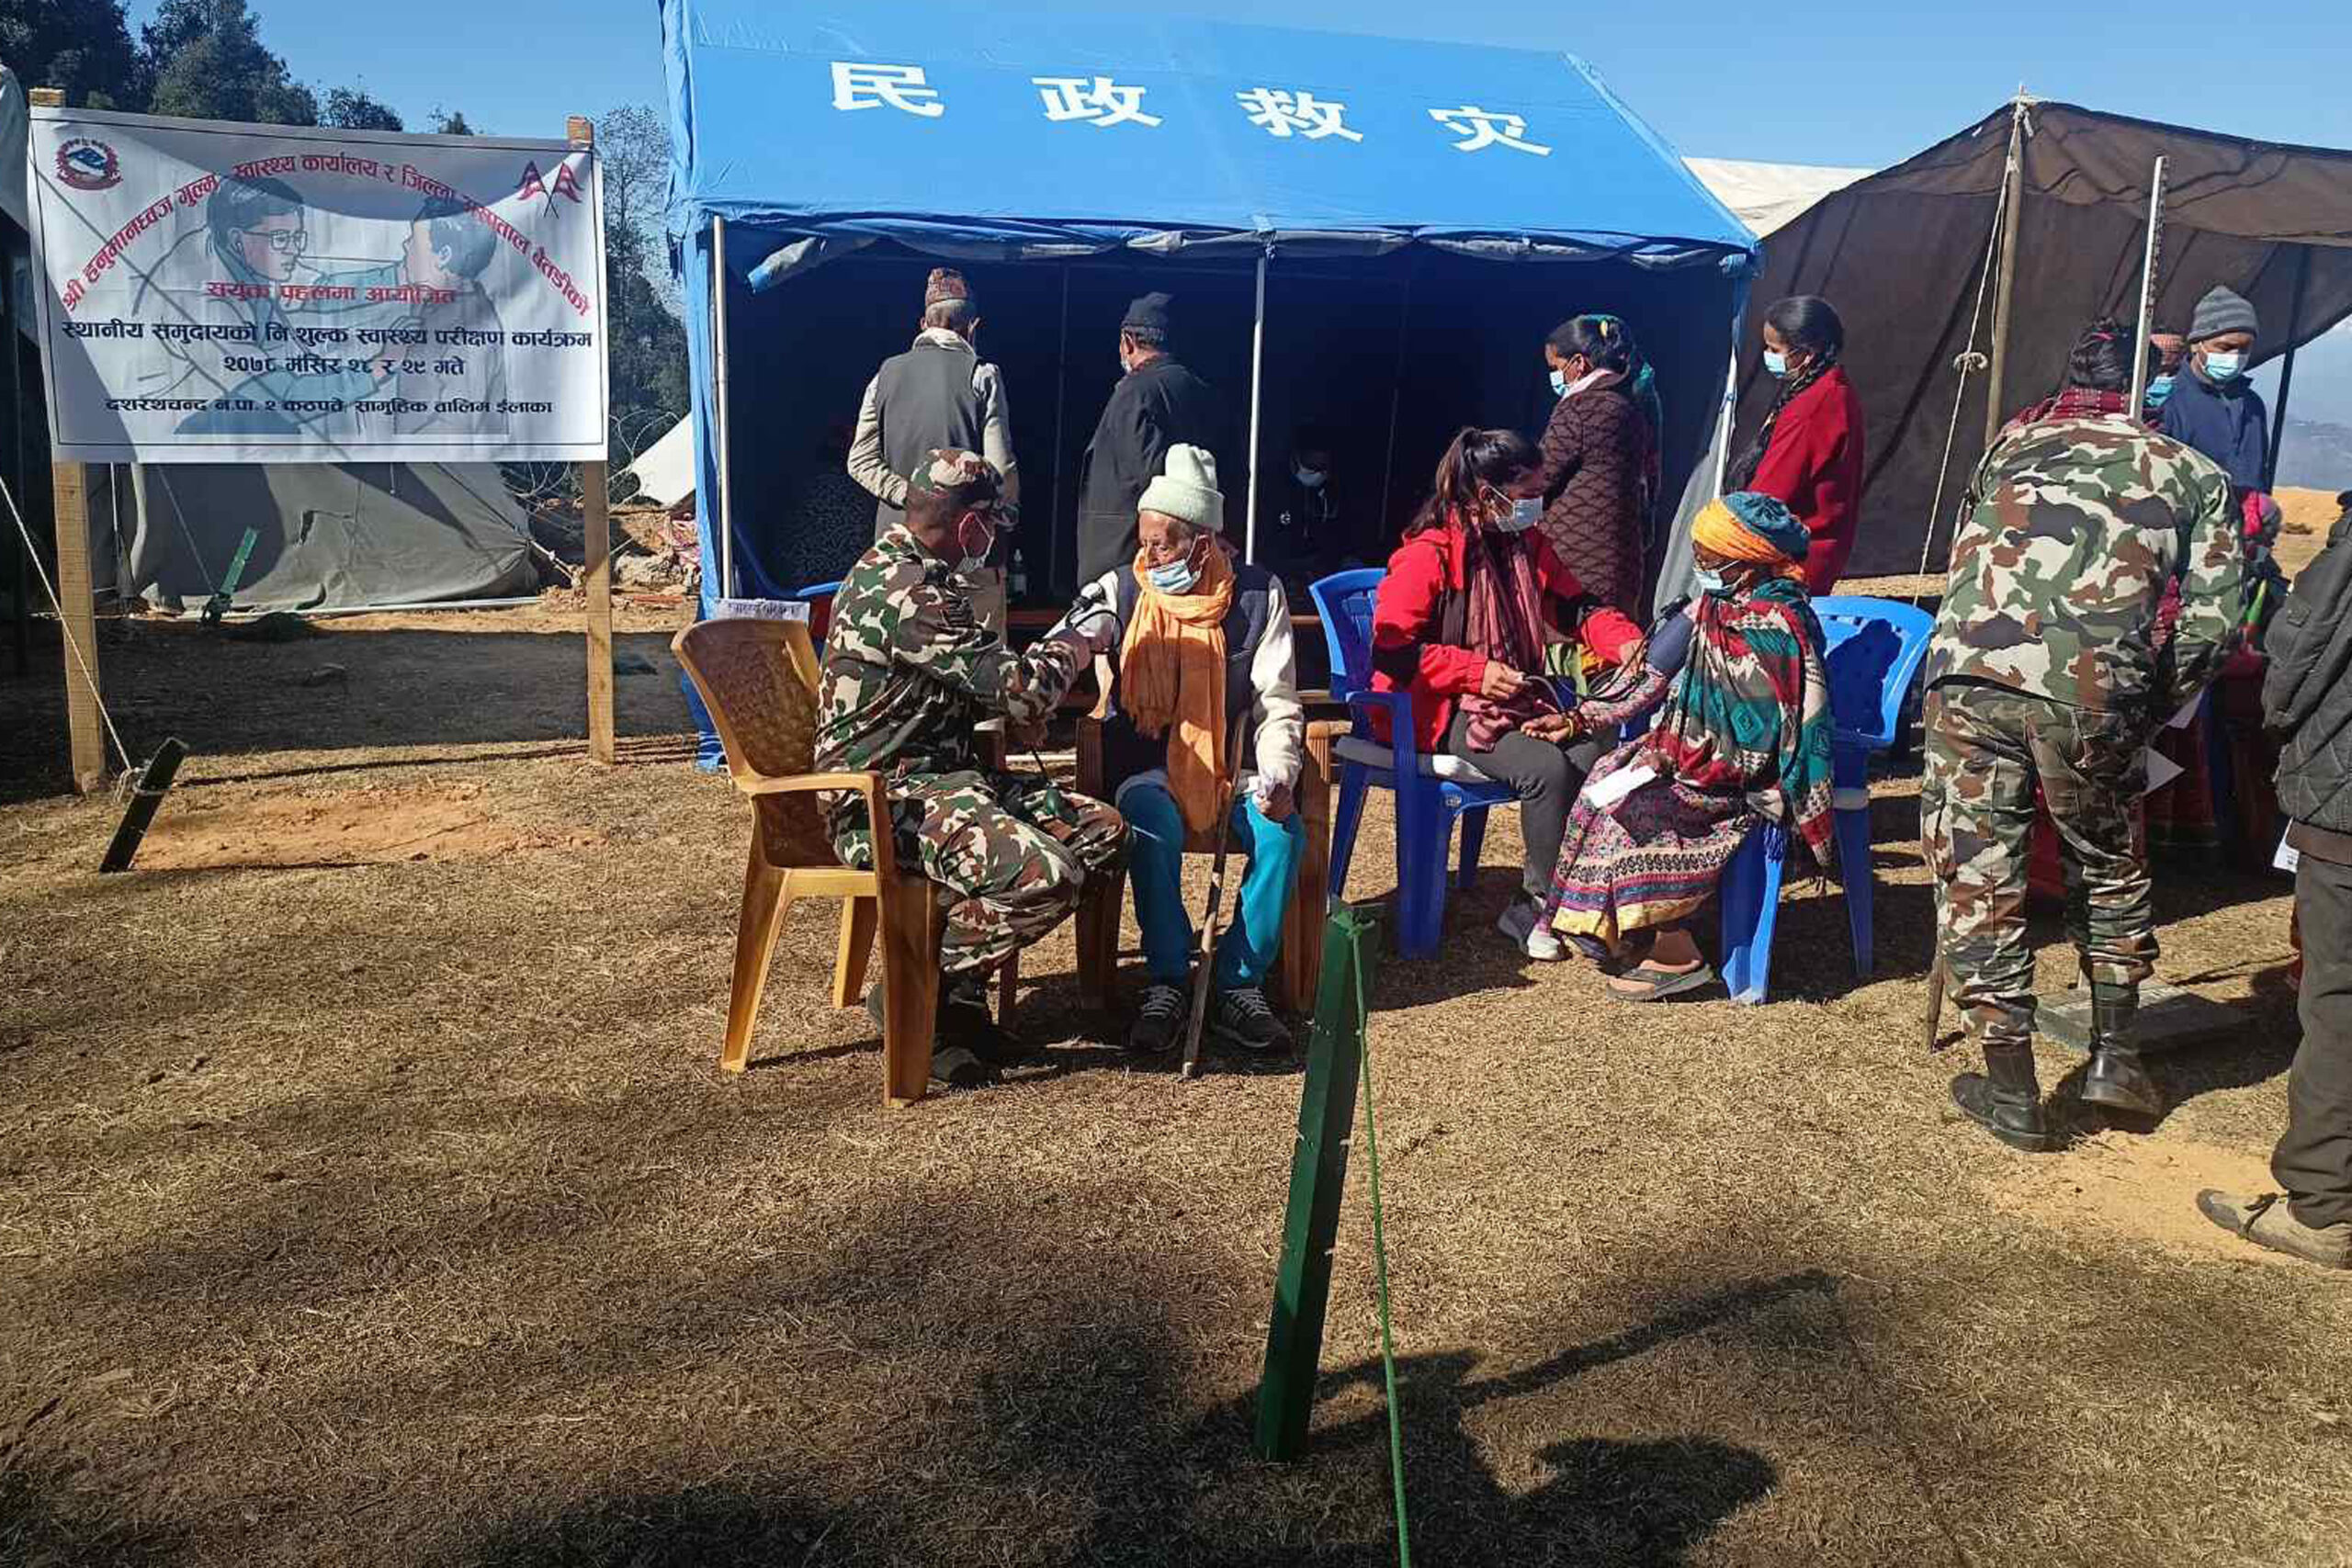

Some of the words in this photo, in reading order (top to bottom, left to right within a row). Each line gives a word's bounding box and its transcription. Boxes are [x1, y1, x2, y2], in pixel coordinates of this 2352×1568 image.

[830, 61, 1552, 158] 民政救灾
[62, 279, 85, 311] श्री
[300, 152, 379, 177] कार्यालय
[382, 164, 395, 183] र
[62, 319, 143, 340] स्थानीय
[152, 321, 257, 344] समुदायको
[435, 326, 504, 347] परीक्षण
[512, 328, 593, 348] कार्यक्रम
[380, 358, 396, 375] र
[434, 355, 465, 376] गते
[435, 397, 491, 413] तालिम
